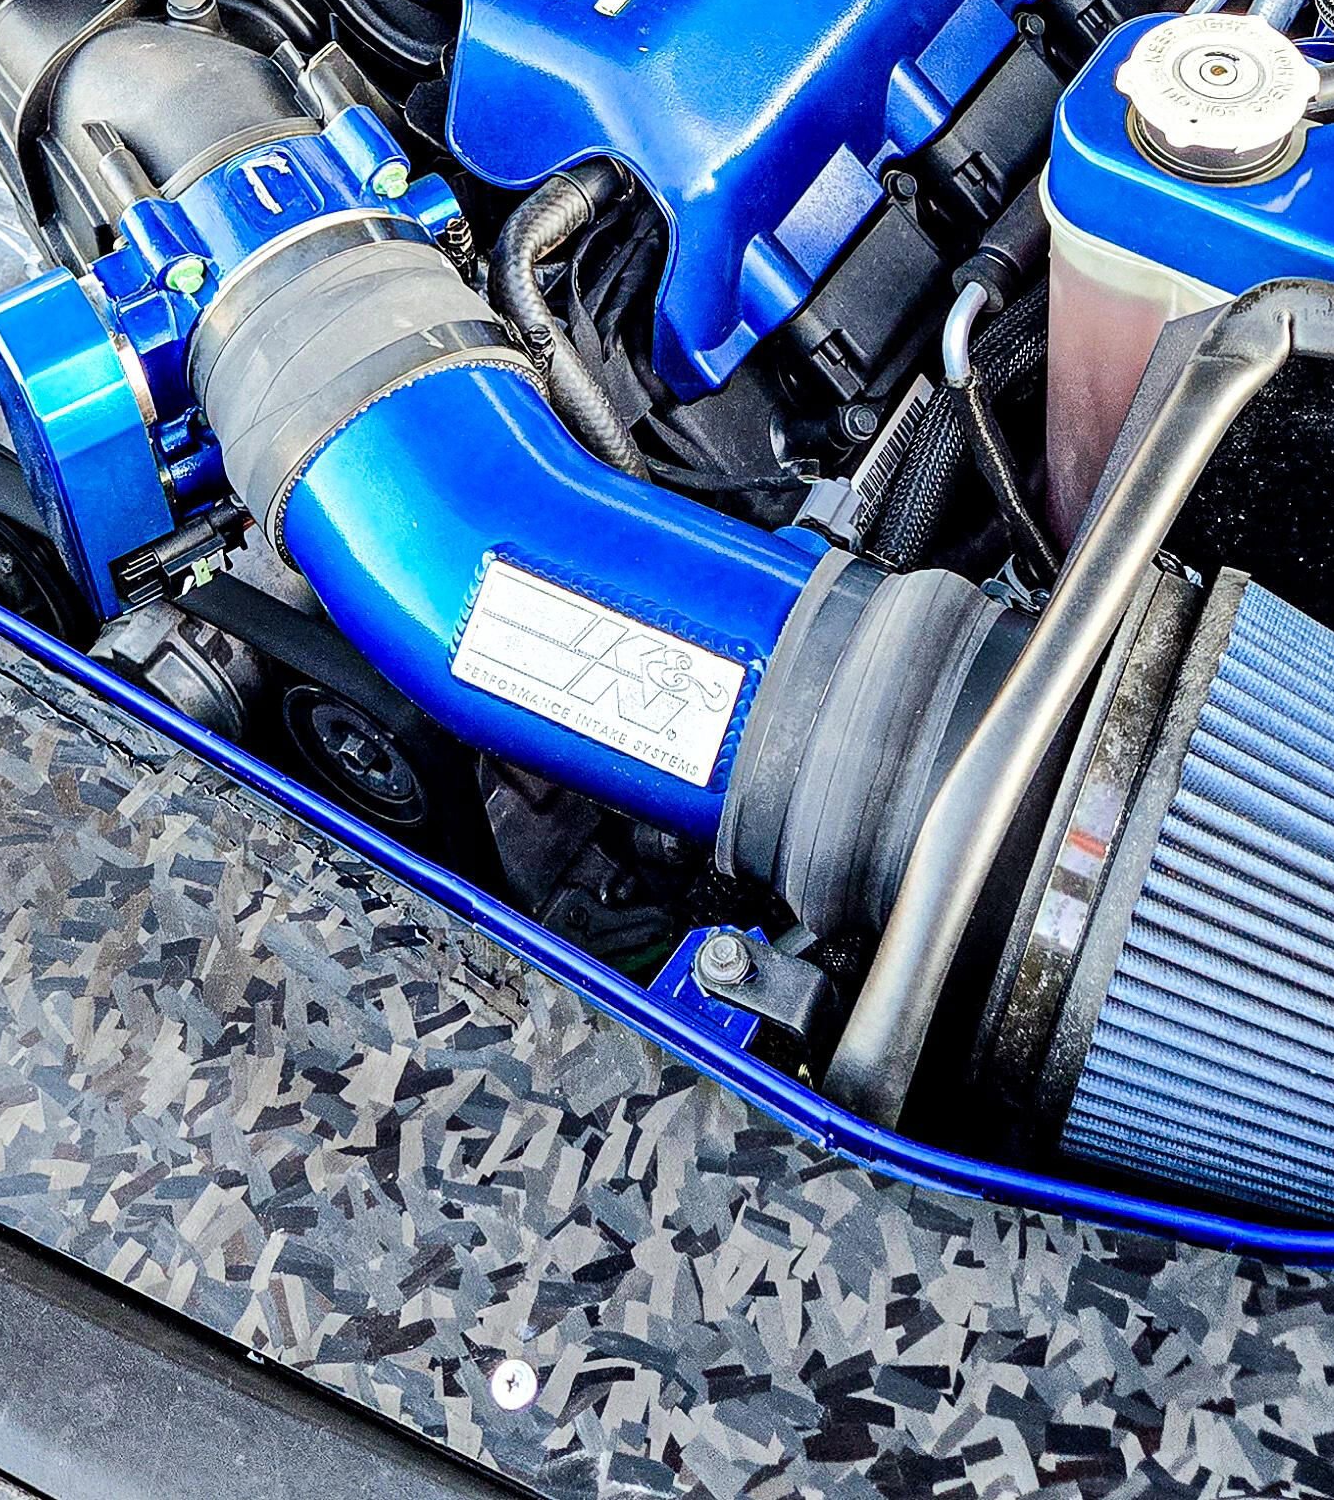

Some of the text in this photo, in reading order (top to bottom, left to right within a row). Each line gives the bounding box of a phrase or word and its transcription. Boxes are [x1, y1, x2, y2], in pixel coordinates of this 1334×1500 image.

[464, 661, 701, 778] PERFORMANCE INTAKE SYSTEMS
